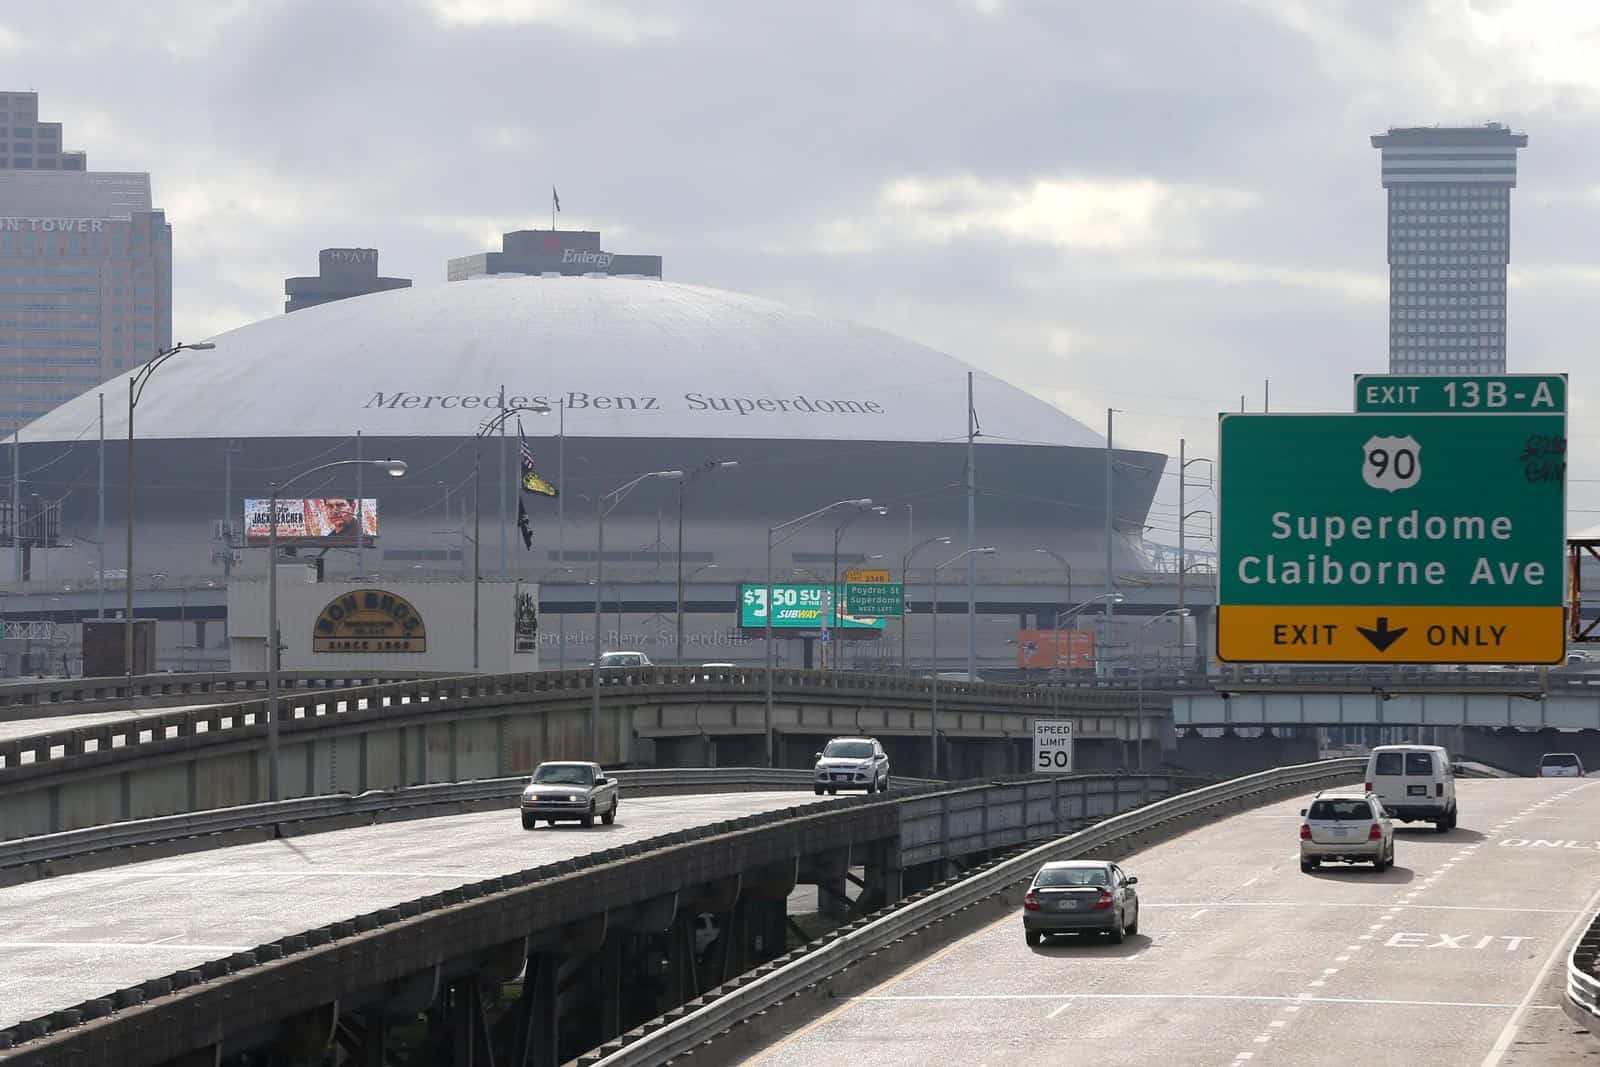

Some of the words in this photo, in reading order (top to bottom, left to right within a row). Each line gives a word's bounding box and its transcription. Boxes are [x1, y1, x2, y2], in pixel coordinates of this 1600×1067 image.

[28, 218, 103, 232] TOWER
[561, 248, 614, 267] Entergy
[684, 392, 885, 416] Superdome
[1366, 386, 1421, 404] EXIT
[1443, 382, 1555, 408] 13B-A
[1369, 448, 1415, 479] 90
[1271, 510, 1513, 547] Superdome
[1238, 554, 1447, 585] Claiborne
[1470, 557, 1546, 585] Ave
[800, 588, 832, 601] SU
[850, 596, 901, 606] Superdome
[777, 609, 821, 619] SUBWAY
[1273, 624, 1338, 645] EXIT
[1427, 624, 1506, 646] ONLY
[1037, 725, 1070, 734] SPEED
[1040, 738, 1067, 746] LIMIT
[1039, 750, 1068, 768] 50
[1499, 839, 1600, 849] ONL
[1384, 932, 1535, 951] EXIT
